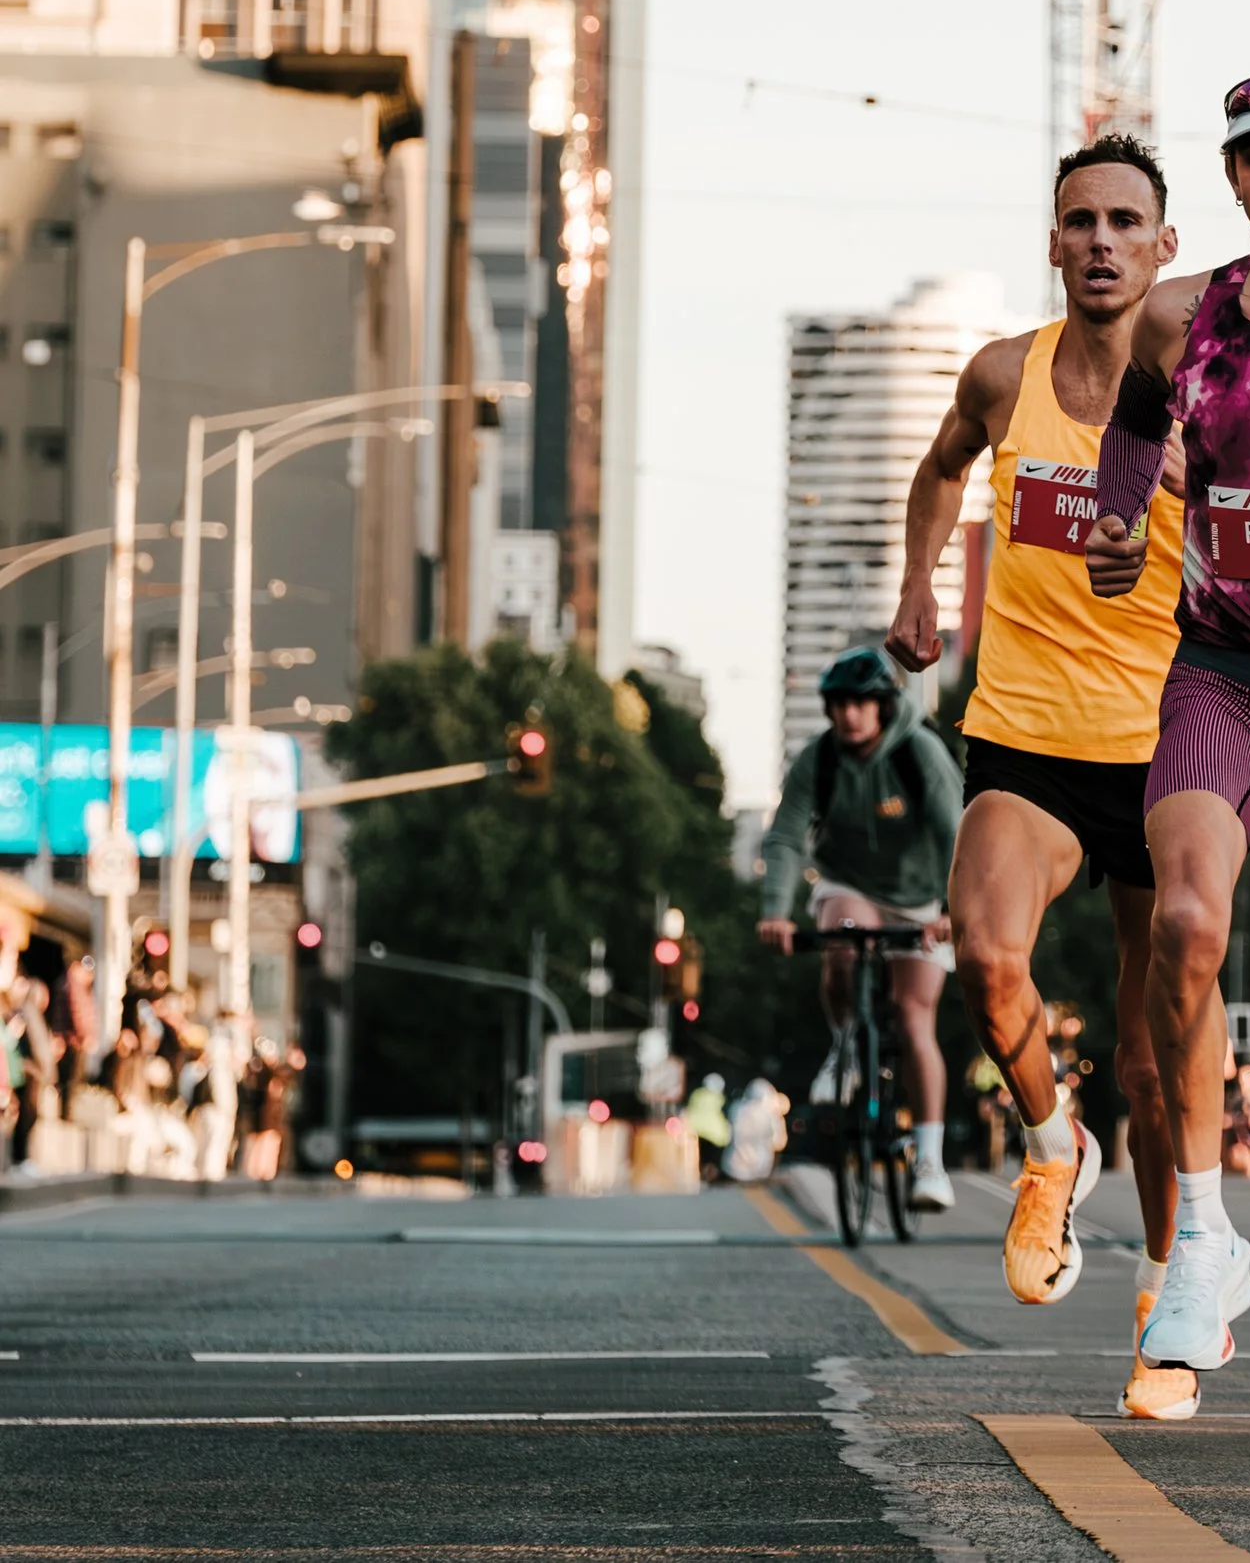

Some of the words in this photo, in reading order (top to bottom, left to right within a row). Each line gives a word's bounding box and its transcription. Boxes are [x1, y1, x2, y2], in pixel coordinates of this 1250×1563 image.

[1012, 490, 1023, 526] MARATHON
[1055, 493, 1098, 520] RYAN
[1066, 521, 1079, 543] 4
[1211, 522, 1220, 560] MARATHON
